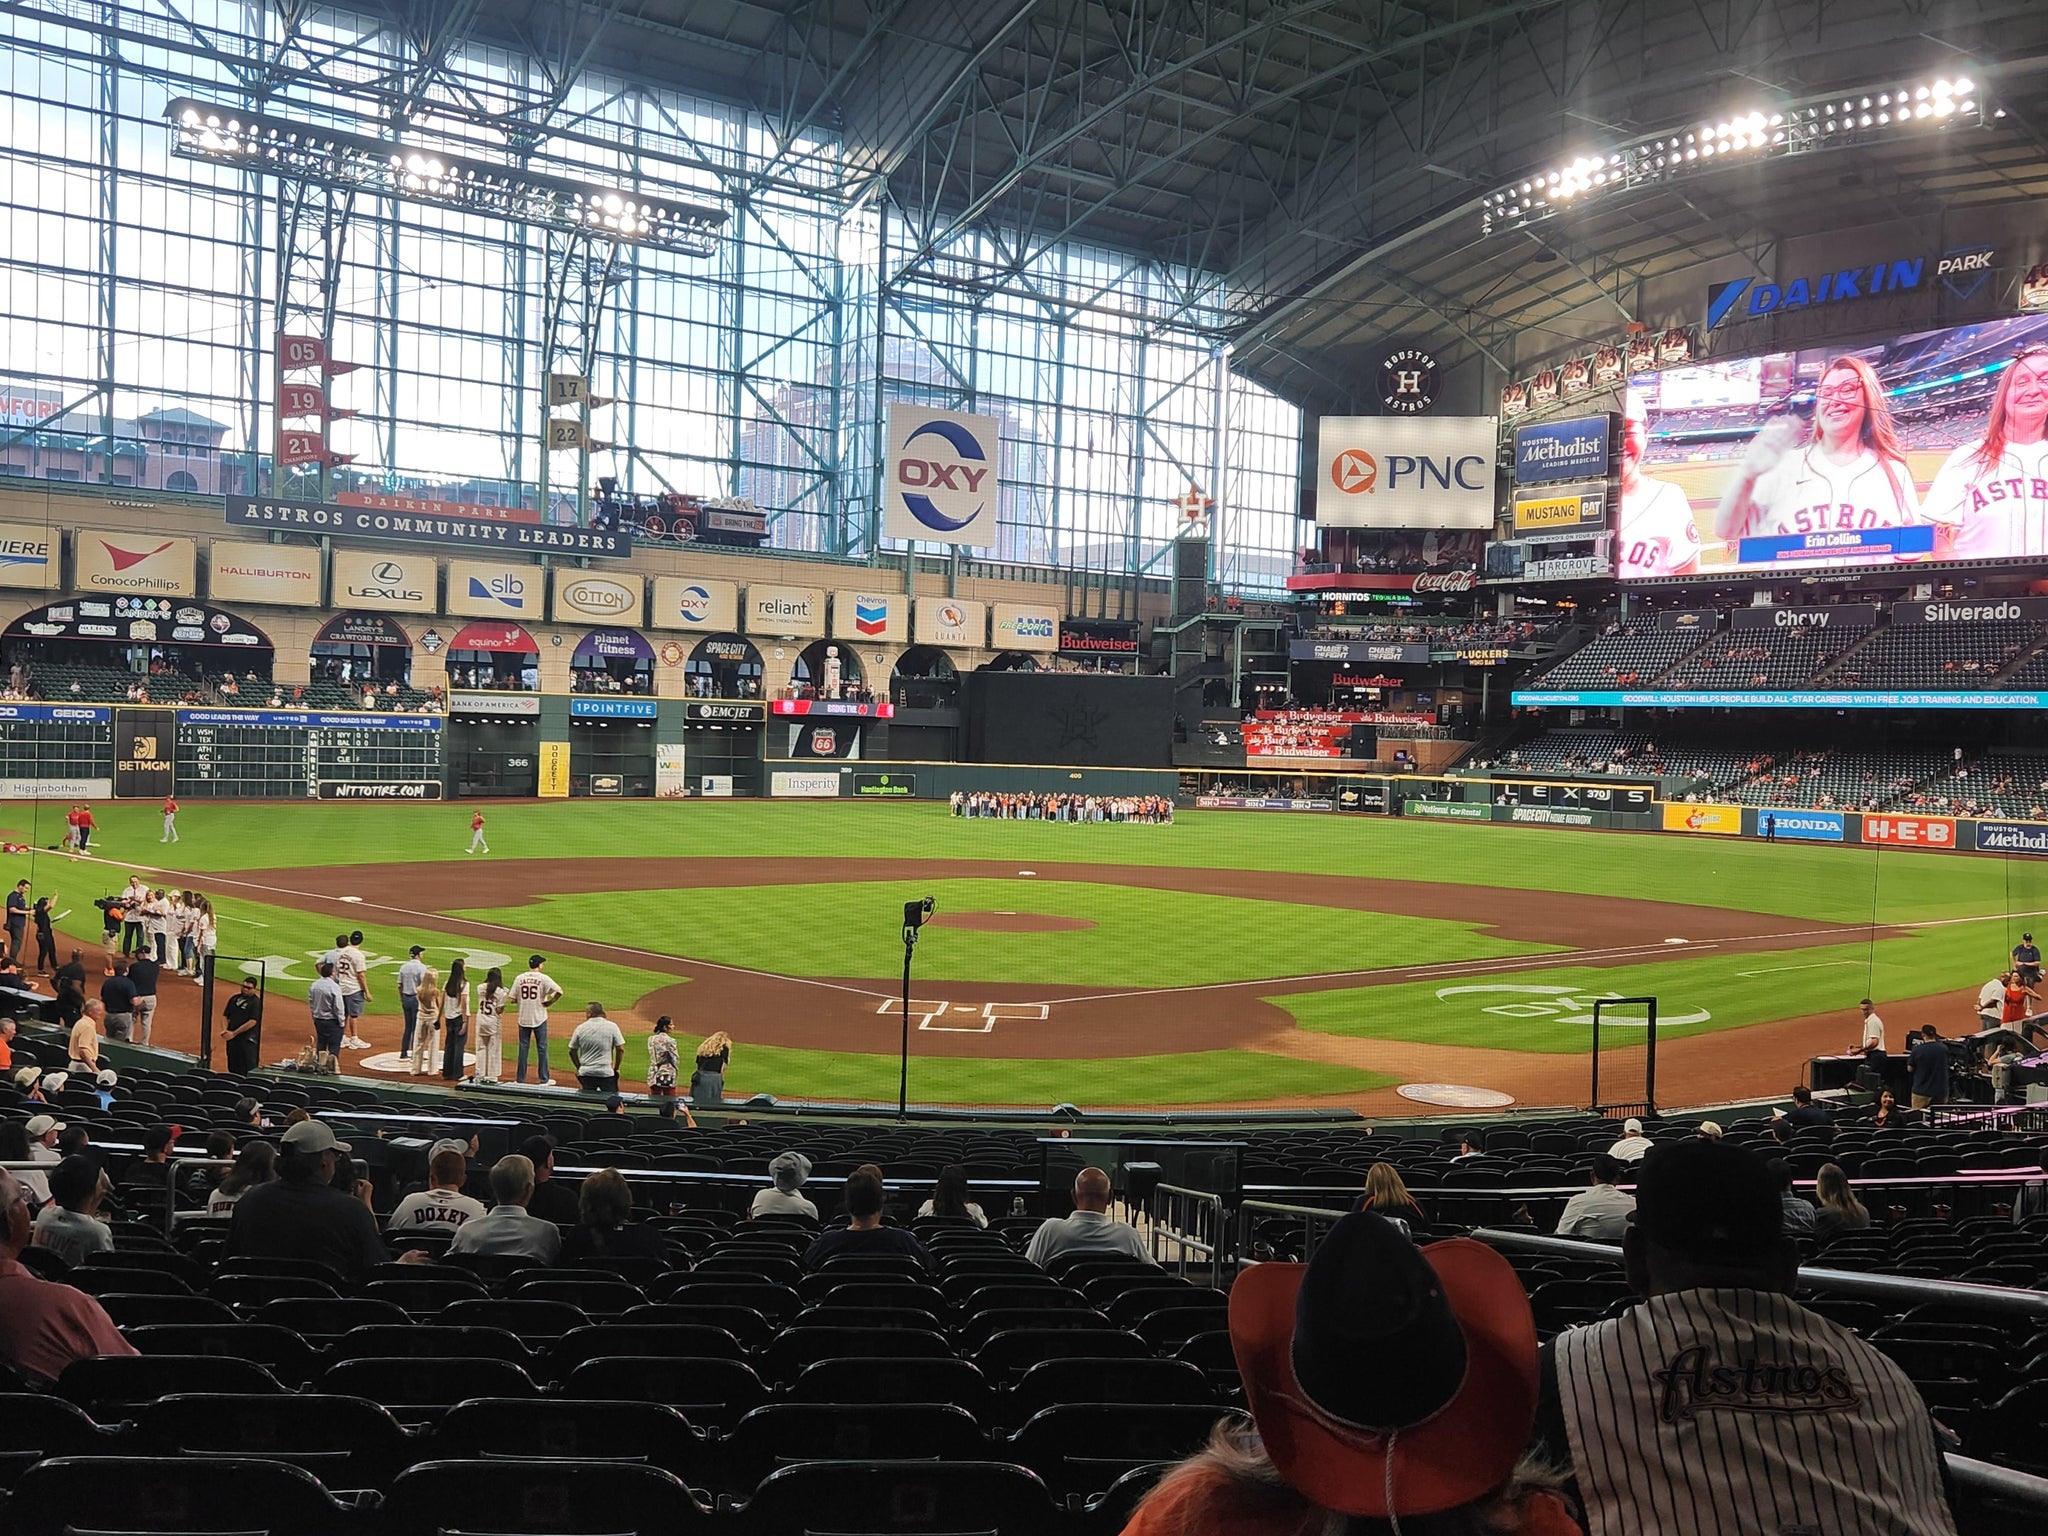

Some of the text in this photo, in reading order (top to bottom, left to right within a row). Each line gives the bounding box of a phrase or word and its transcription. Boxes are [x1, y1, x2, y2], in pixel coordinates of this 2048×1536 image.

[1747, 250, 1994, 316] DAIKIN PARK
[1660, 328, 1687, 349] 42
[289, 343, 316, 361] 05
[1629, 337, 1652, 357] 34
[1384, 350, 1437, 370] HOUSTON
[1564, 360, 1586, 380] 25
[1397, 370, 1421, 393] H
[1533, 370, 1555, 391] 40
[557, 382, 578, 397] 17
[1503, 383, 1524, 404] 32
[290, 392, 315, 409] 19
[1384, 395, 1431, 412] ASTROS
[556, 428, 577, 442] 22
[1522, 437, 1554, 447] HOUSTON
[288, 437, 312, 454] 21
[1522, 436, 1601, 463] Methodist
[1542, 456, 1600, 468] LEADING MEDICINE
[899, 458, 989, 494] OXY
[1384, 455, 1485, 491] PNC
[363, 496, 508, 518] DAIKIN PARK
[1526, 505, 1575, 521] MUSTANG
[1582, 501, 1602, 516] CAT
[1777, 503, 1892, 534] STRO
[245, 504, 616, 550] ASTROS COMMUNITY LEADERS
[1806, 533, 1862, 547] Erin Collins
[220, 566, 311, 580] HALLIBURTON
[1537, 559, 1597, 579] HARGROVE
[91, 574, 181, 590] ConocoPhillips
[491, 573, 524, 595] slb
[1820, 575, 1861, 583] CHEVROLET
[348, 586, 423, 601] LEXUS
[573, 586, 624, 609] COTTON
[856, 594, 888, 605] Chevron
[1322, 592, 1371, 601] HORNITOS
[681, 599, 708, 608] OXY
[758, 598, 808, 616] reliant
[115, 608, 172, 620] LANDRY'S
[1924, 602, 2021, 622] Silverado
[343, 625, 384, 633] LANDRY'S
[999, 620, 1048, 631] FREEPORT
[1017, 617, 1053, 637] LNG
[330, 633, 372, 641] CRAWFORD
[469, 637, 502, 647] equinor
[594, 632, 630, 645] planet
[935, 631, 967, 641] QUANTA
[1061, 633, 1137, 651] Budweiser
[598, 643, 635, 655] fitness
[706, 641, 748, 655] SPACE CITY
[1325, 651, 1349, 659] FIGHT
[1456, 649, 1509, 659] PLUCKERS
[1379, 652, 1403, 660] FIGHT
[1332, 673, 1404, 687] Budweiser
[1623, 695, 2039, 704] GOODWILL HOUSTON HELPS PEOPLE BUILD ALL-STAR CAREERS WITH FREE JOB TRAINING AND EDUCATION.
[53, 708, 96, 719] GEICO
[577, 703, 652, 714] 1POINTFIVE
[711, 707, 752, 718] EMCJET
[1289, 711, 1343, 721] Budweiser
[816, 739, 831, 749] 66
[1275, 746, 1330, 757] Budweiser
[119, 760, 171, 771] BETMGM
[309, 732, 317, 795] AMERICAN
[508, 759, 528, 767] 366
[14, 784, 88, 793] Higginbotham
[336, 784, 425, 798] NITTOTIRE.COM
[788, 778, 837, 791] Insperity
[861, 786, 908, 795] Huntington Bank
[1587, 789, 1606, 798] 370
[1421, 804, 1449, 814] National
[1512, 808, 1593, 825] SPACE CITY HOME NETWORK
[1775, 818, 1842, 832] HONDA
[1868, 820, 1949, 842] H-E-B
[521, 985, 538, 999] 86
[414, 1207, 470, 1226] DOXEY
[1652, 1344, 1858, 1424] Astros
